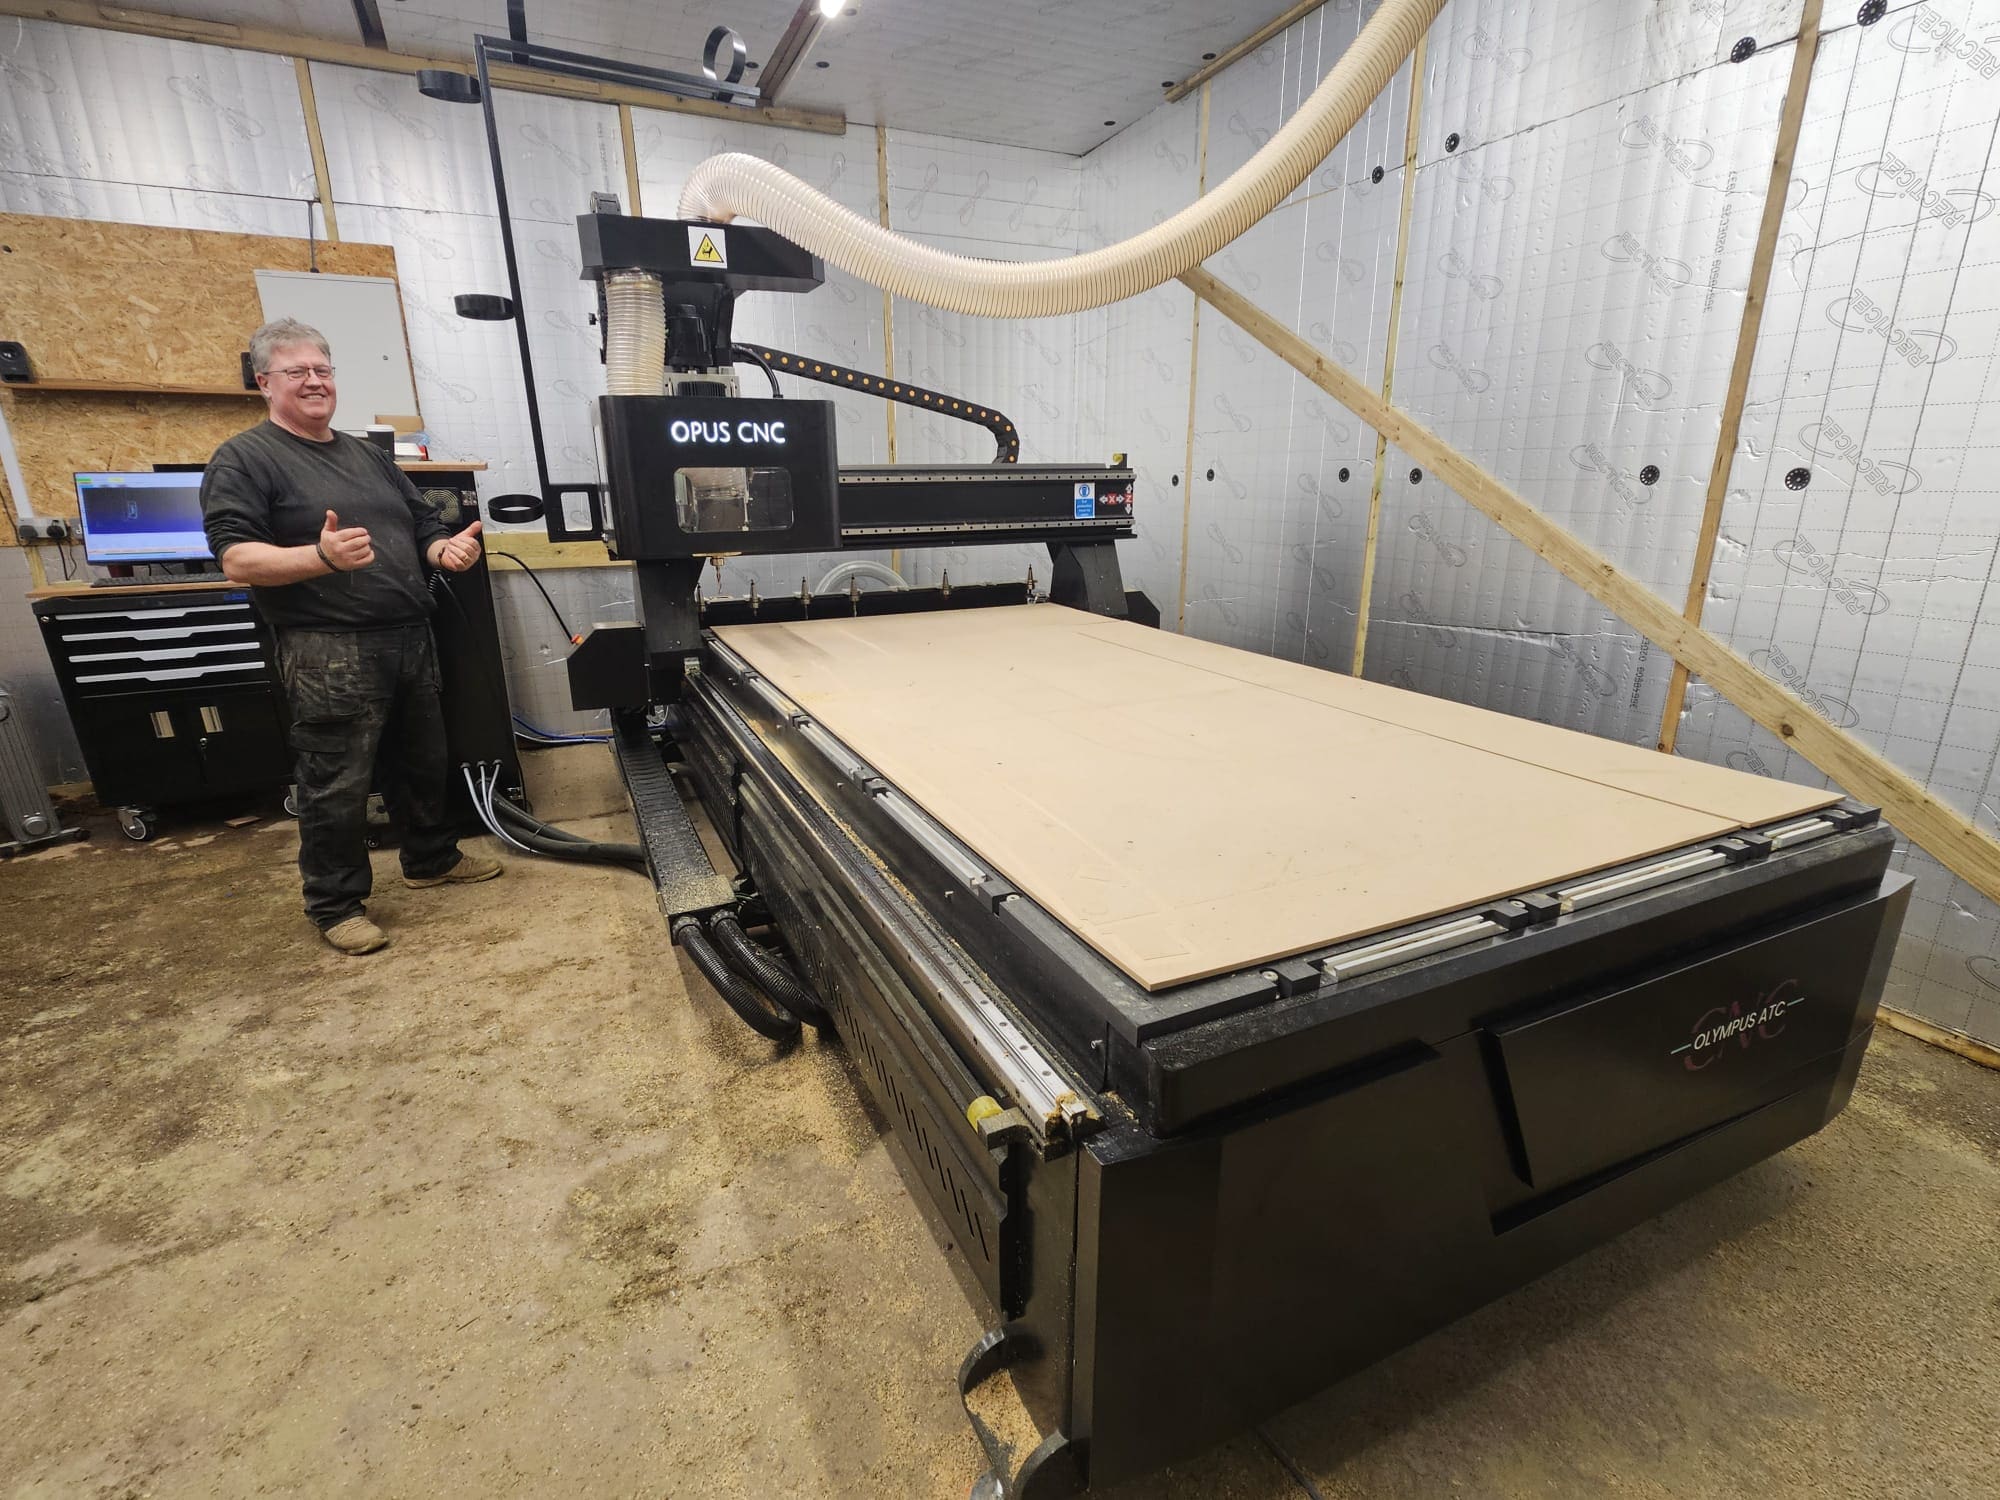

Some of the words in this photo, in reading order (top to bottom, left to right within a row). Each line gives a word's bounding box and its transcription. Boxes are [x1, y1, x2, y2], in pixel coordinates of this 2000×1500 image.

[1880, 152, 1965, 230] RECTICEL
[1848, 288, 1929, 368] RECTICEL
[671, 421, 731, 443] OPUS
[737, 421, 786, 444] CNC
[1820, 415, 1897, 496] RECTICEL
[1793, 534, 1866, 615] RECTICEL
[1693, 1012, 1757, 1050] OLYMPUS
[1757, 1001, 1786, 1025] ATC
